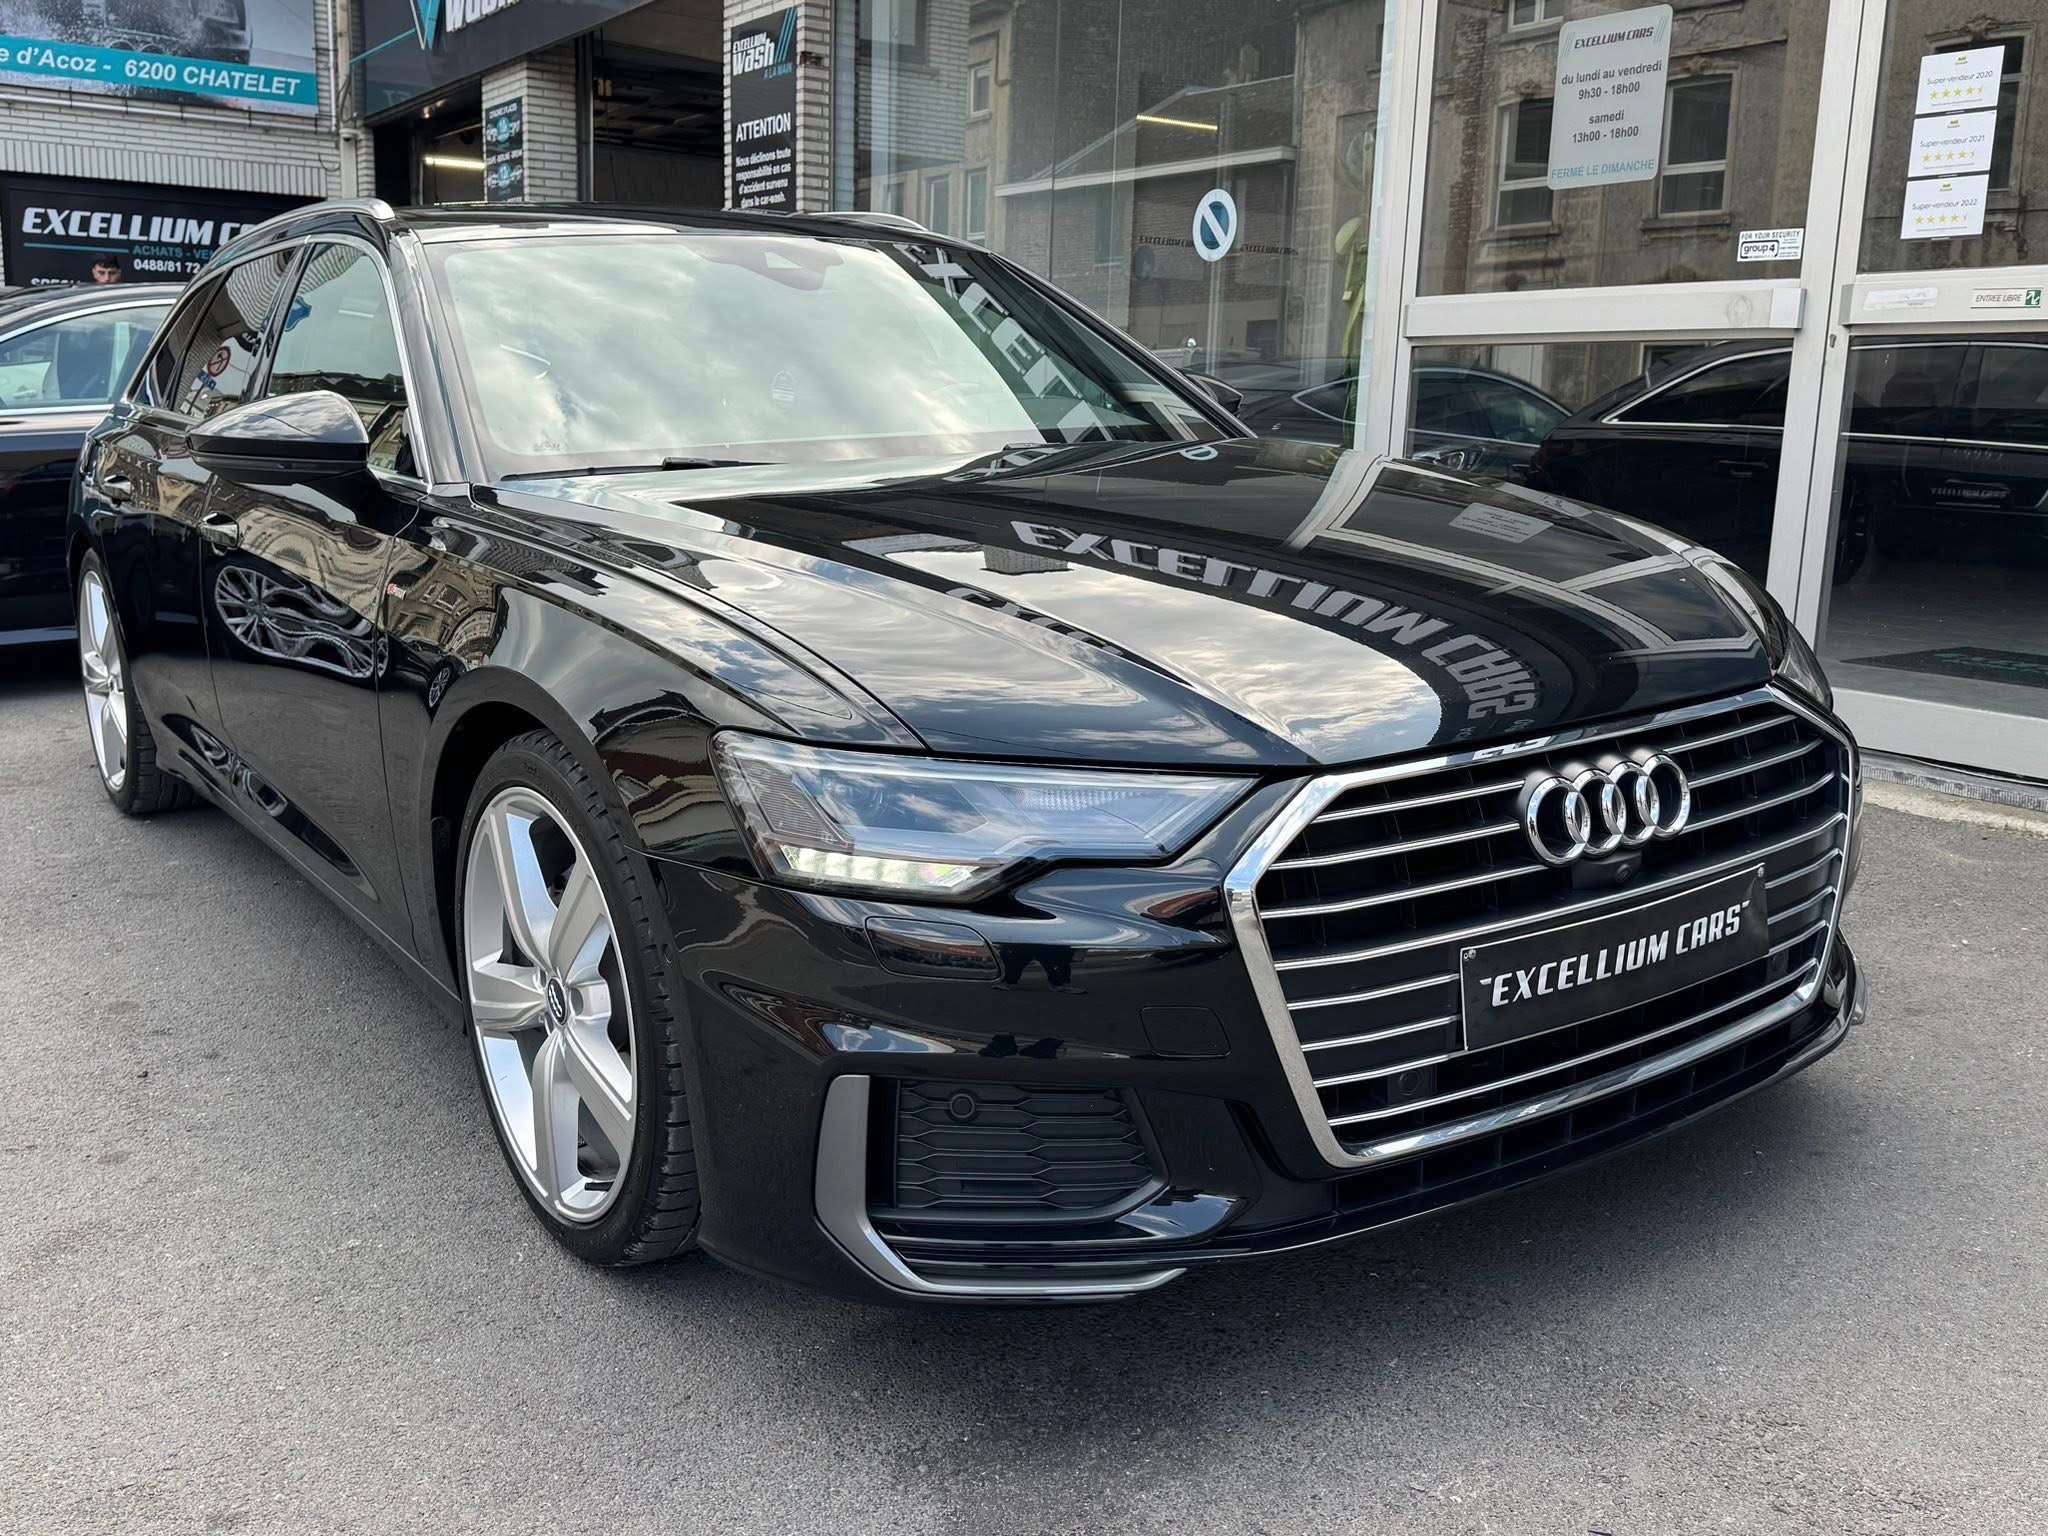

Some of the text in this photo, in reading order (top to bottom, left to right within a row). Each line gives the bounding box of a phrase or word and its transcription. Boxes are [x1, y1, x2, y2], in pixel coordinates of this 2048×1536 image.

[1574, 26, 1655, 49] EXCELLIUM CARS
[124, 59, 177, 81] 6200
[183, 66, 300, 97] CHATELET
[1561, 59, 1662, 85] du lundi au vendredi
[1975, 70, 1993, 80] 2020
[1578, 85, 1602, 100] 9h30
[1611, 81, 1640, 96] 18h00
[1588, 109, 1625, 125] samedi
[736, 111, 791, 143] ATTENTION
[1572, 130, 1600, 144] 13h00
[1610, 125, 1639, 141] 18h00
[1968, 134, 1985, 143] 2021
[1586, 164, 1600, 176] LE
[1601, 159, 1655, 174] DIMANCHE
[1960, 198, 1978, 207] 2022
[22, 207, 215, 245] EXCELLIUM
[133, 244, 183, 257] ACHATS
[133, 259, 182, 272] 0488/81
[1491, 903, 1742, 1008] EXCELLIUM CARS
